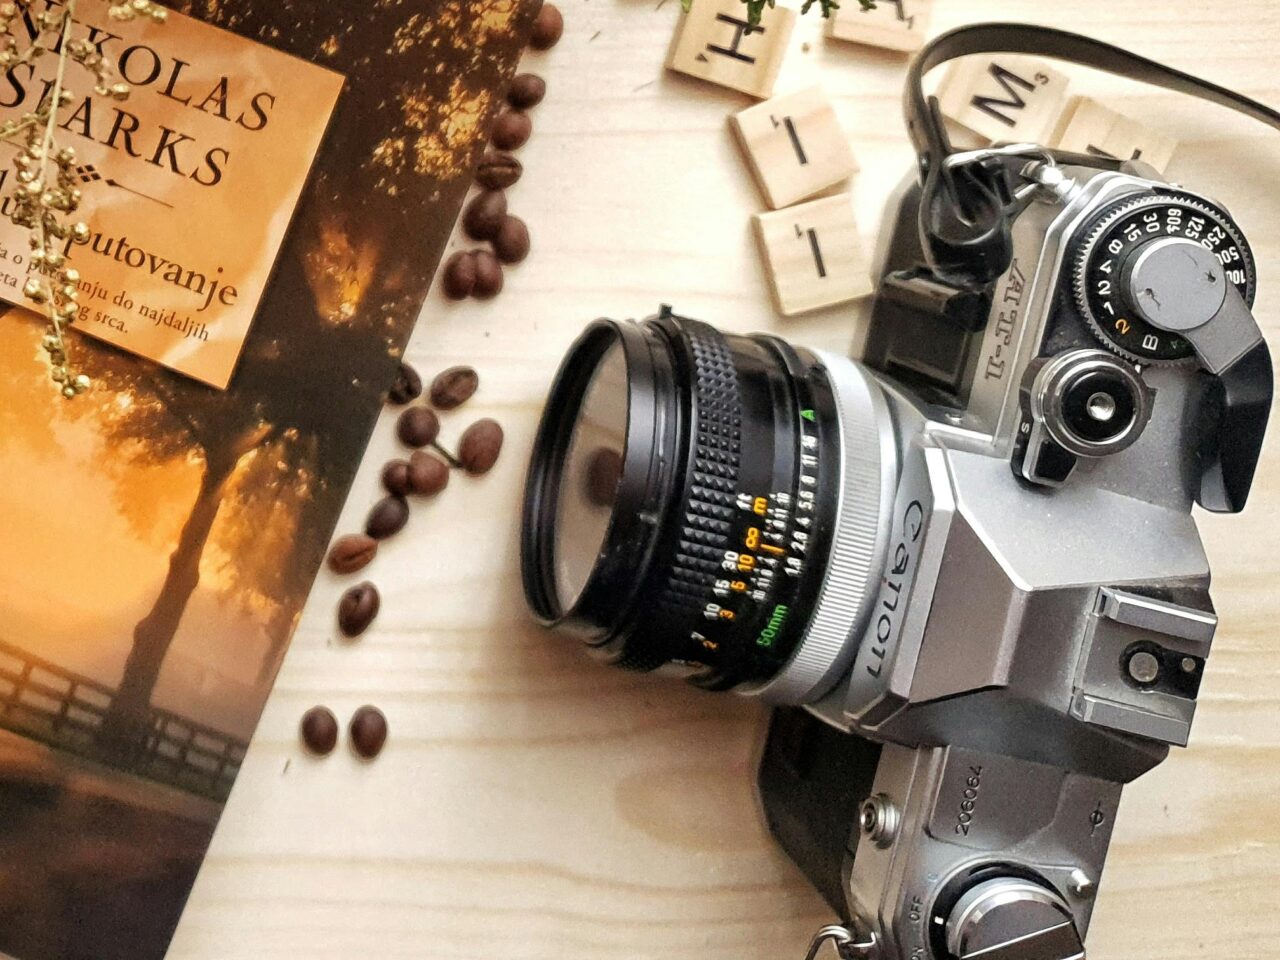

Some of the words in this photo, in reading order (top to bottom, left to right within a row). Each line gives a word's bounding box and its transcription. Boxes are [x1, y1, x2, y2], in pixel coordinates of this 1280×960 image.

[705, 13, 765, 65] H
[970, 62, 1036, 128] M
[1123, 222, 1142, 241] 15
[1143, 212, 1160, 233] 30
[1185, 216, 1205, 239] 125
[1108, 239, 1123, 254] 8
[63, 225, 238, 312] putovanje
[1099, 259, 1113, 274] 4
[1098, 280, 1111, 295] 2
[12, 254, 23, 265] o
[112, 290, 134, 310] do
[138, 303, 209, 342] najdaljih
[1103, 301, 1115, 315] 1
[94, 311, 129, 334] srca.
[1115, 318, 1130, 335] 2
[1142, 334, 1159, 351] B
[800, 409, 817, 422] A
[795, 517, 811, 529] 4
[737, 553, 756, 573] 10
[703, 603, 721, 621] 10
[712, 579, 730, 597] 15
[721, 550, 740, 572] 30
[866, 499, 923, 679] Canon
